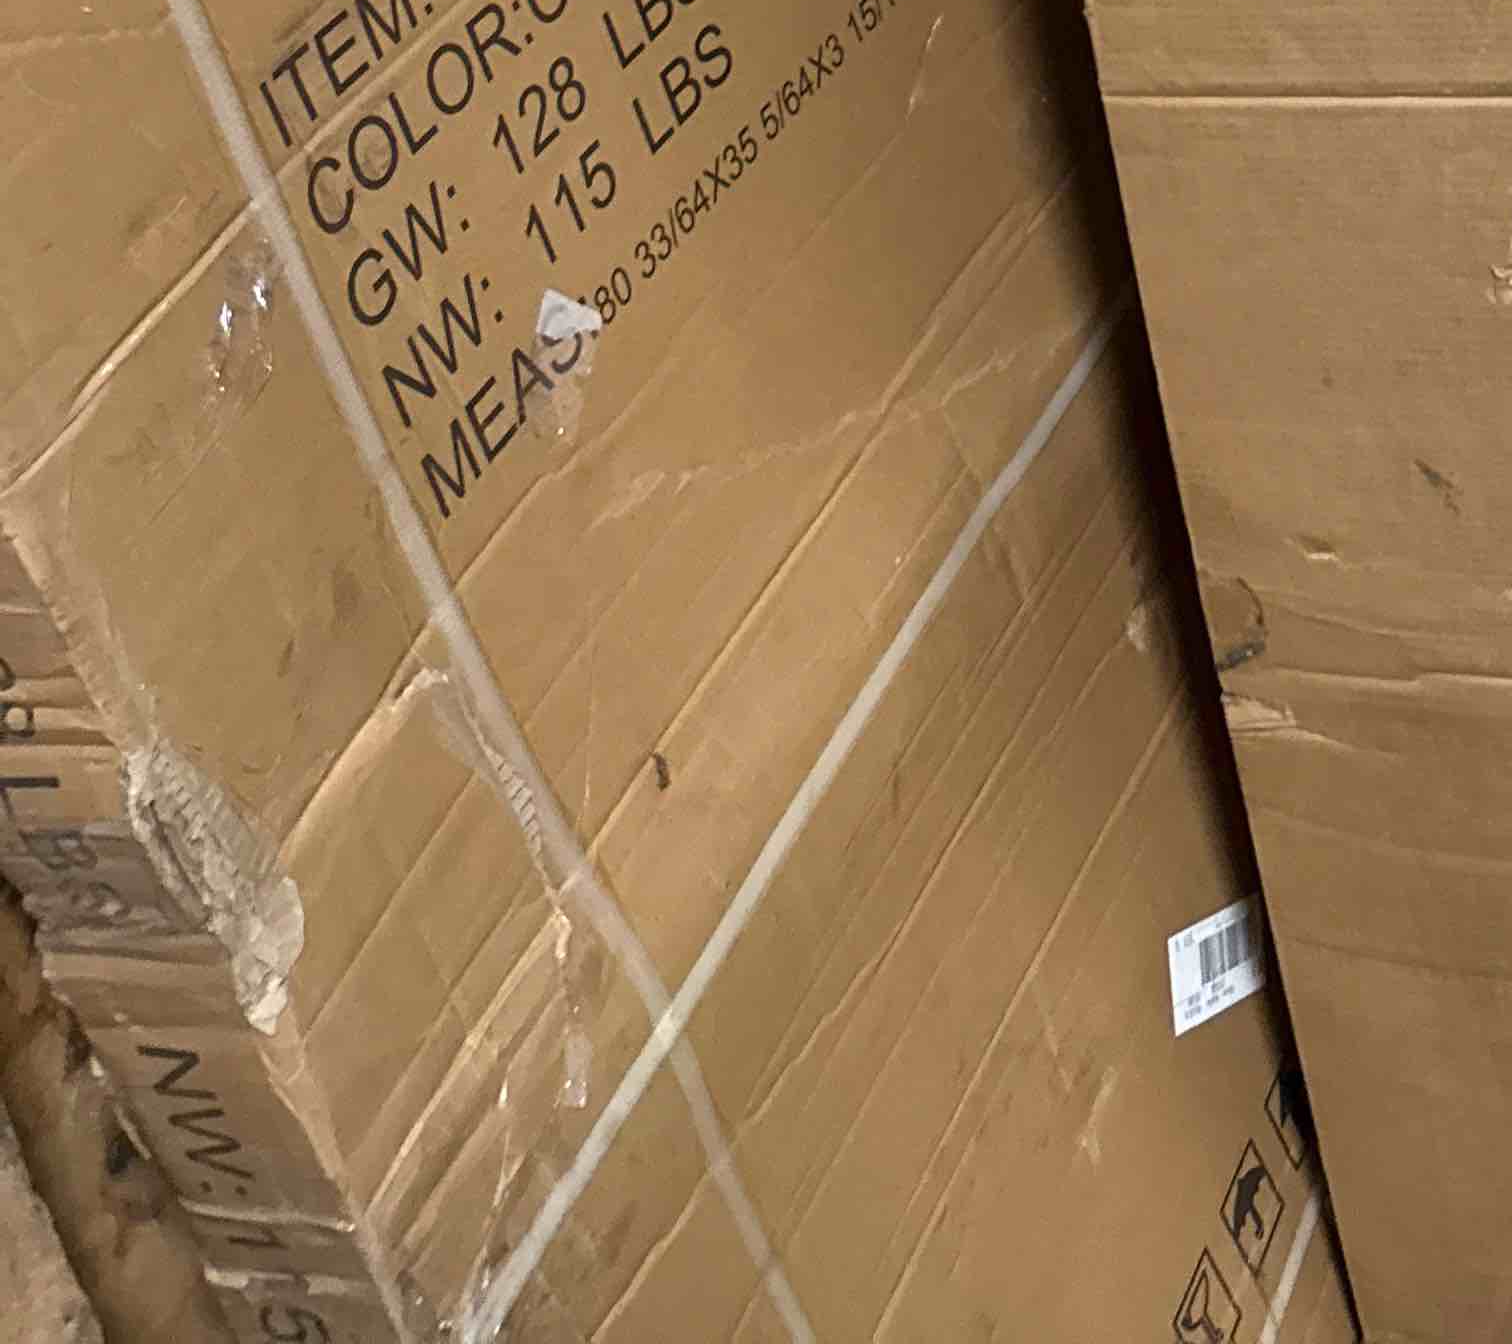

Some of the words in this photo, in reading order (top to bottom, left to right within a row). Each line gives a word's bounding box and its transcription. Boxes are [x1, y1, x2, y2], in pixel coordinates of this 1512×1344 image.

[347, 180, 471, 326] GW:
[492, 55, 587, 174] 128
[382, 273, 504, 427] NW:
[524, 140, 617, 263] 115
[631, 23, 734, 154] LBS
[633, 126, 759, 279] 33/64X35
[759, 33, 846, 141] 5/64X3
[136, 1044, 256, 1197] NW:
